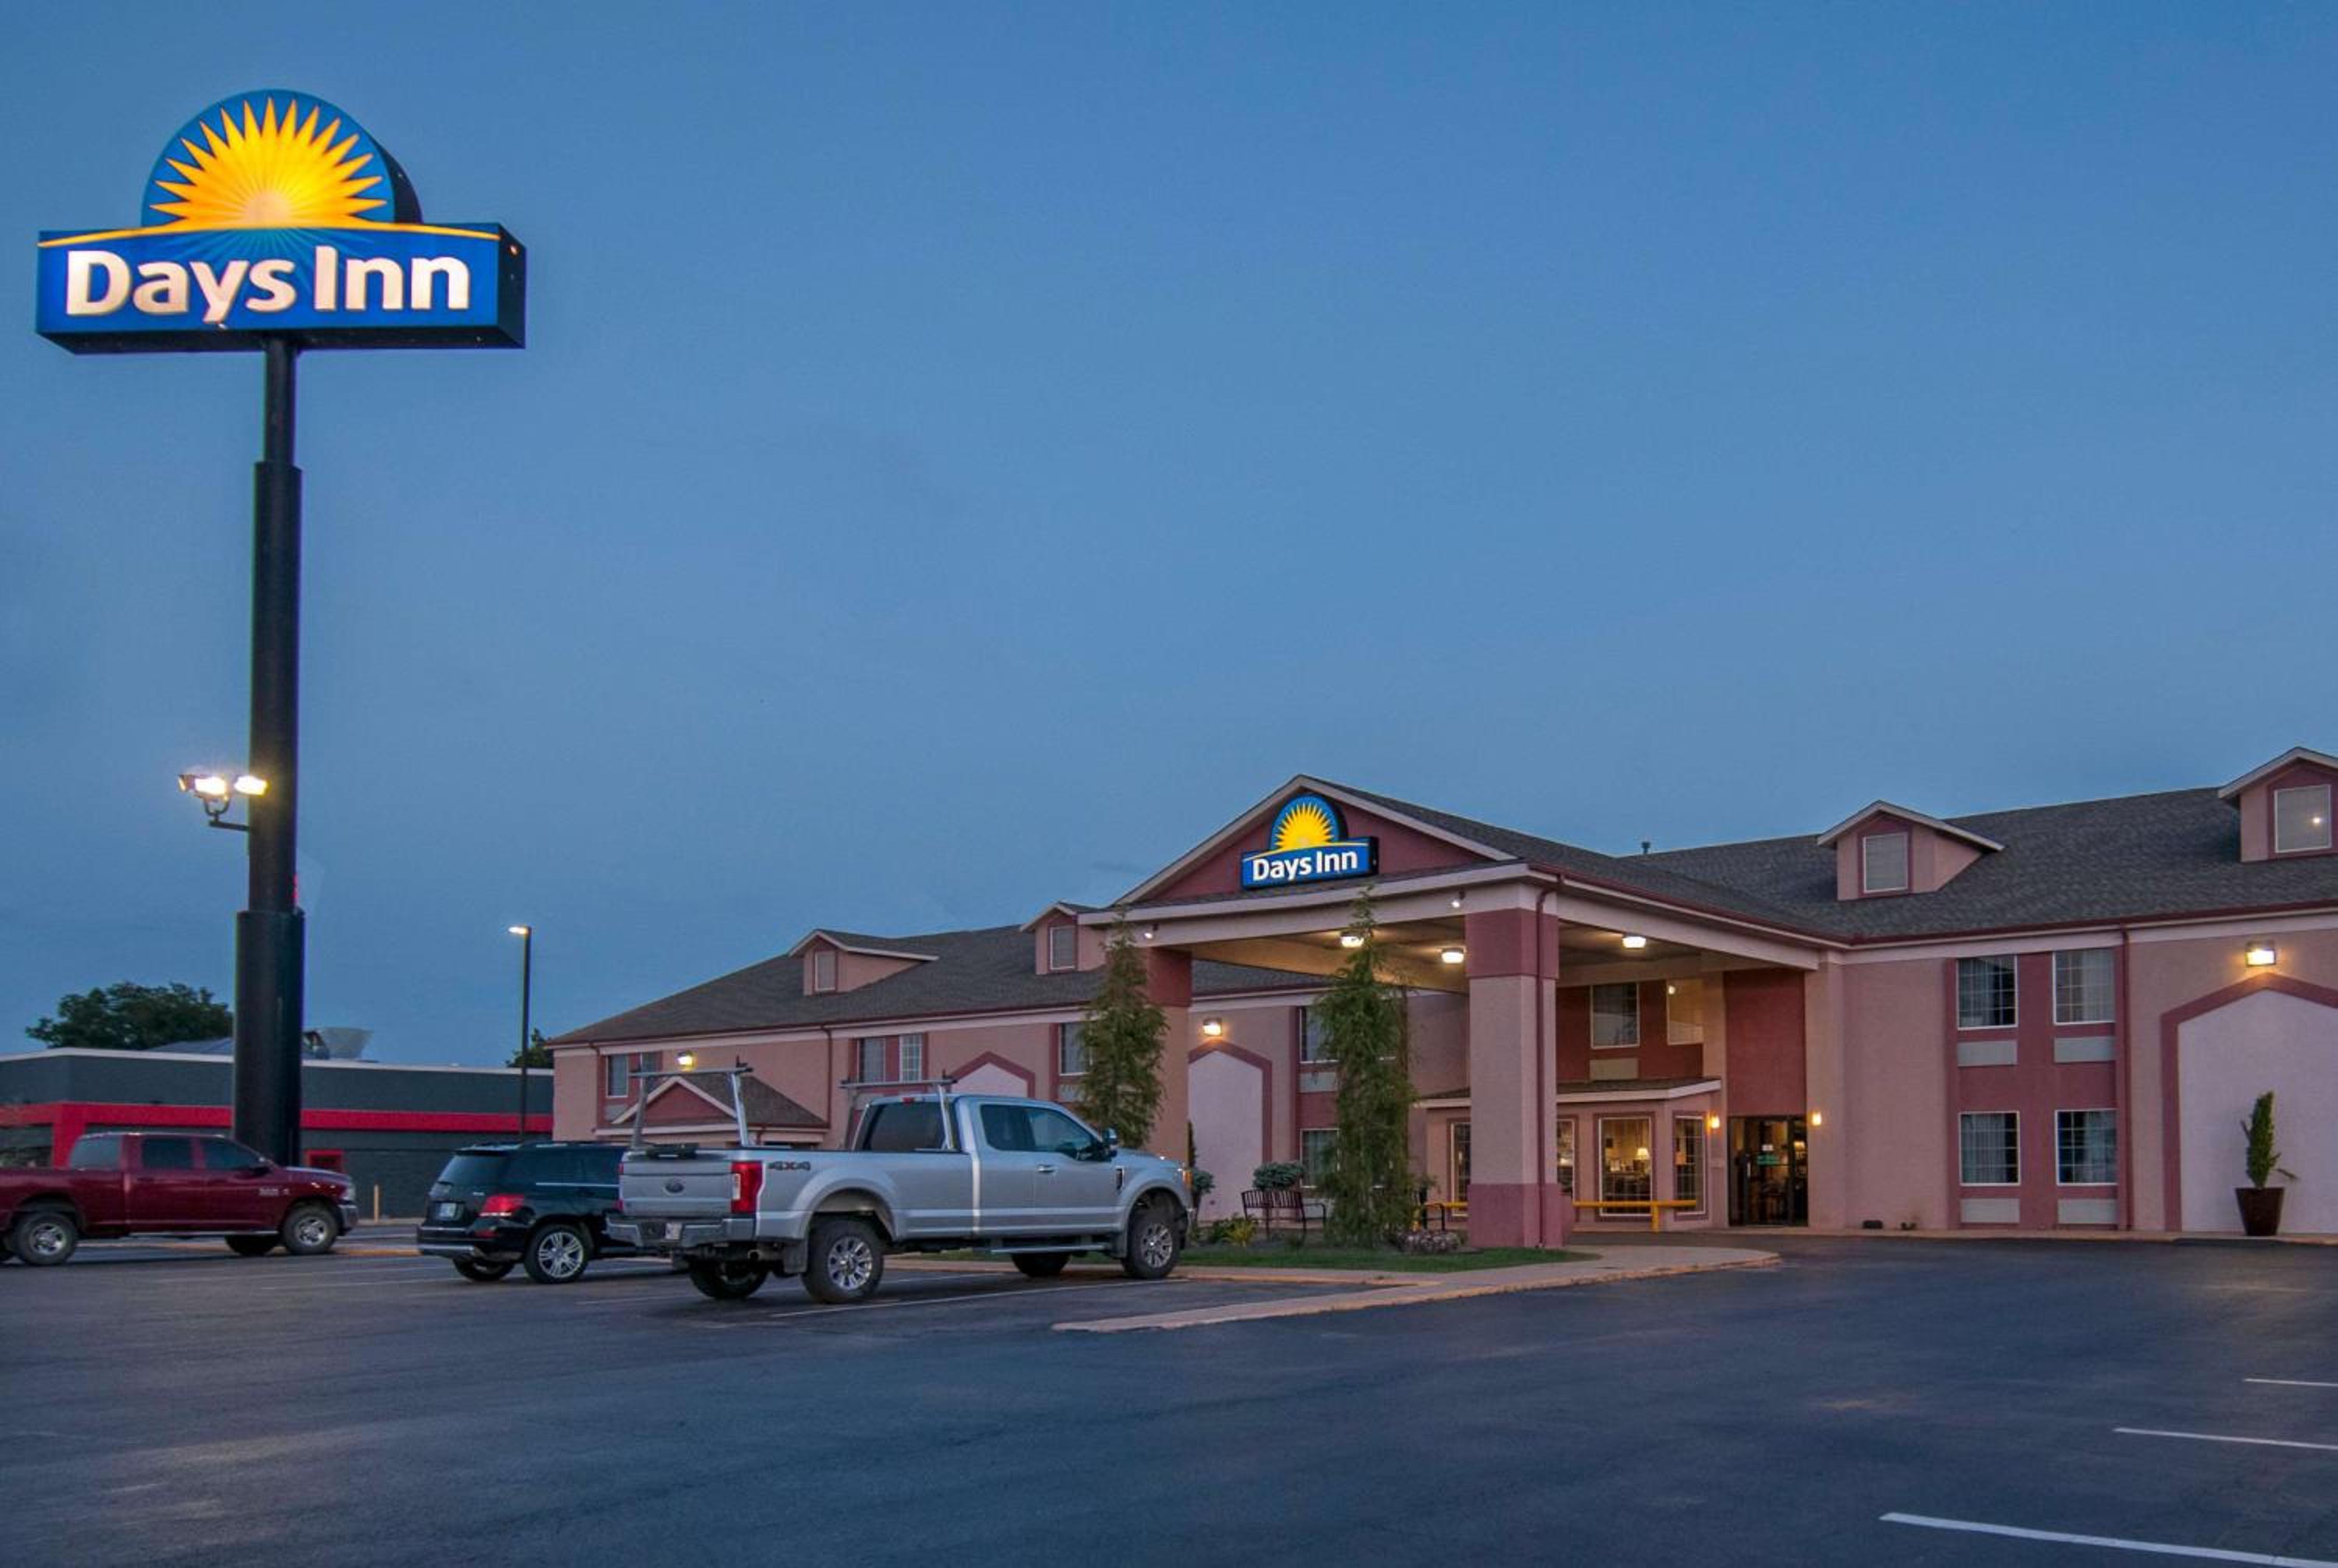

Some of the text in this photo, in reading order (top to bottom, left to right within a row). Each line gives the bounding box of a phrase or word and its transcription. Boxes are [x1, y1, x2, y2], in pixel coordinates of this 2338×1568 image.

[66, 245, 470, 323] Days Inn
[1252, 850, 1358, 881] Days Inn
